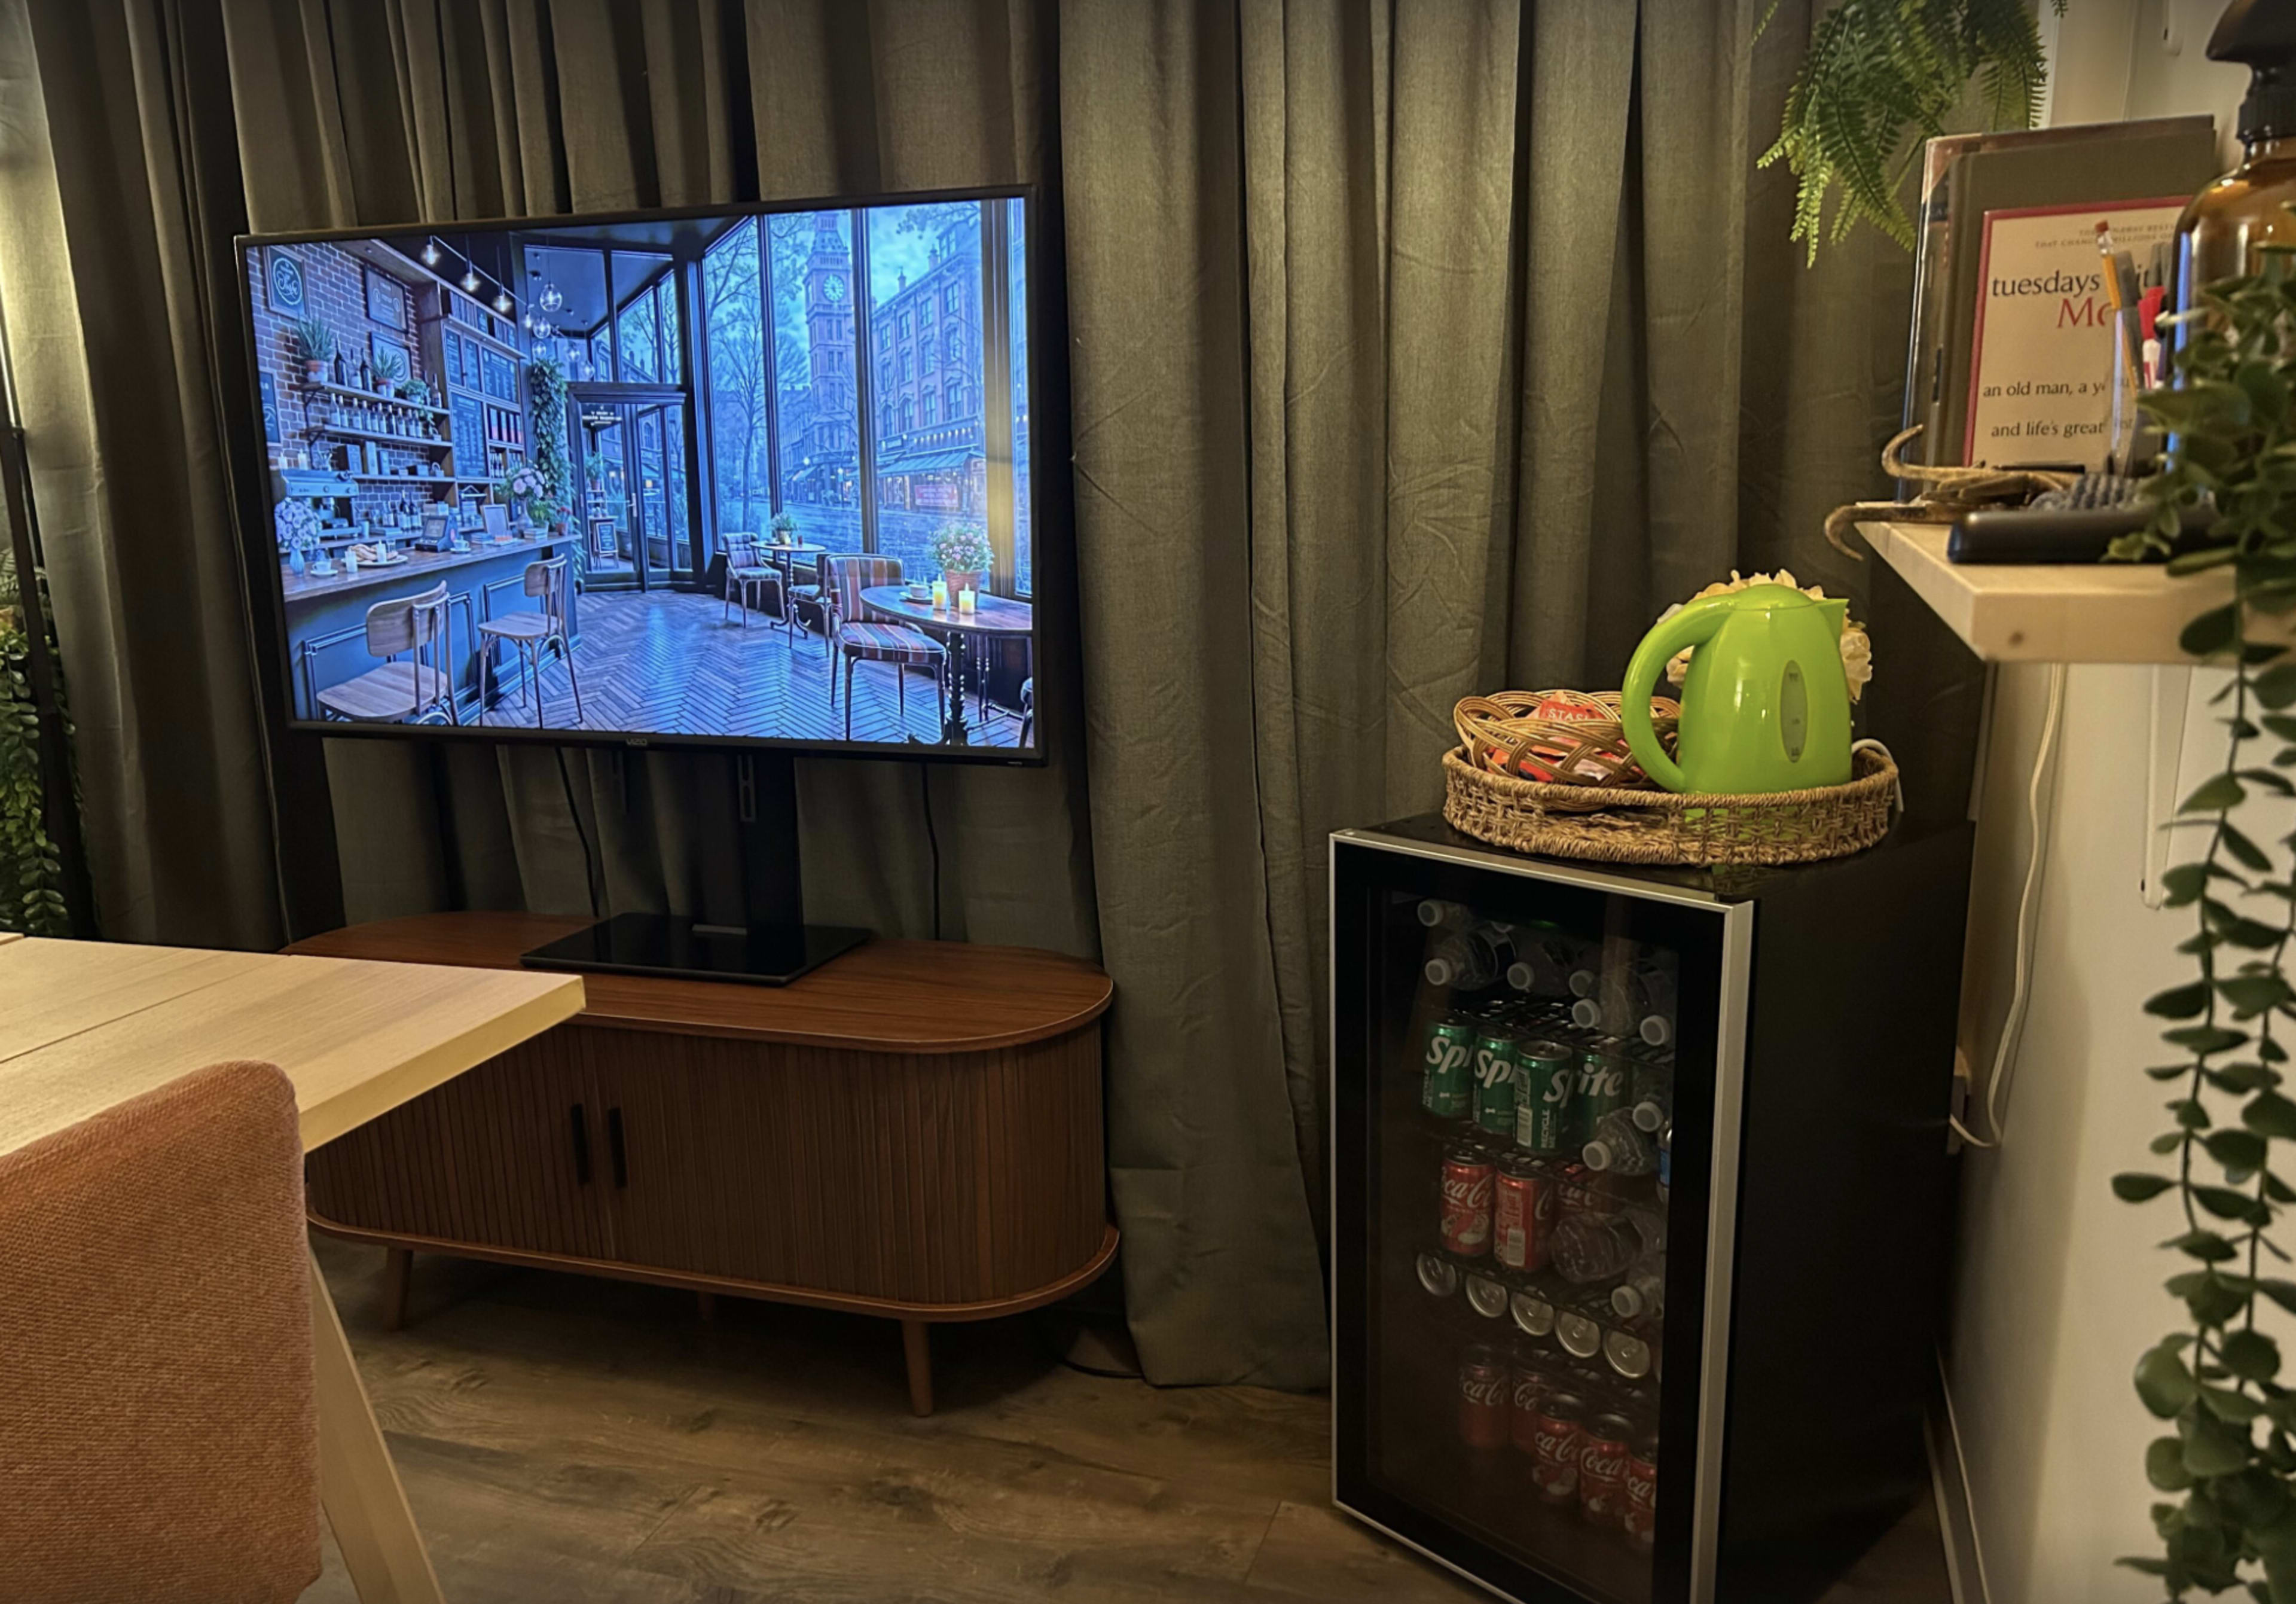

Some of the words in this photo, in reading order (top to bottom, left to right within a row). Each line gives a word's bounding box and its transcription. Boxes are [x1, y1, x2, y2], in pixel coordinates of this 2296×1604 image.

[1992, 269, 2100, 298] tuesdays
[1983, 386, 2001, 398] an
[2006, 380, 2031, 396] old
[2035, 383, 2073, 396] man,
[2078, 383, 2087, 394] a
[1991, 420, 2020, 437] and
[2026, 420, 2059, 436] life's
[2063, 422, 2103, 438] great
[1541, 1109, 1550, 1149] RECYCLE
